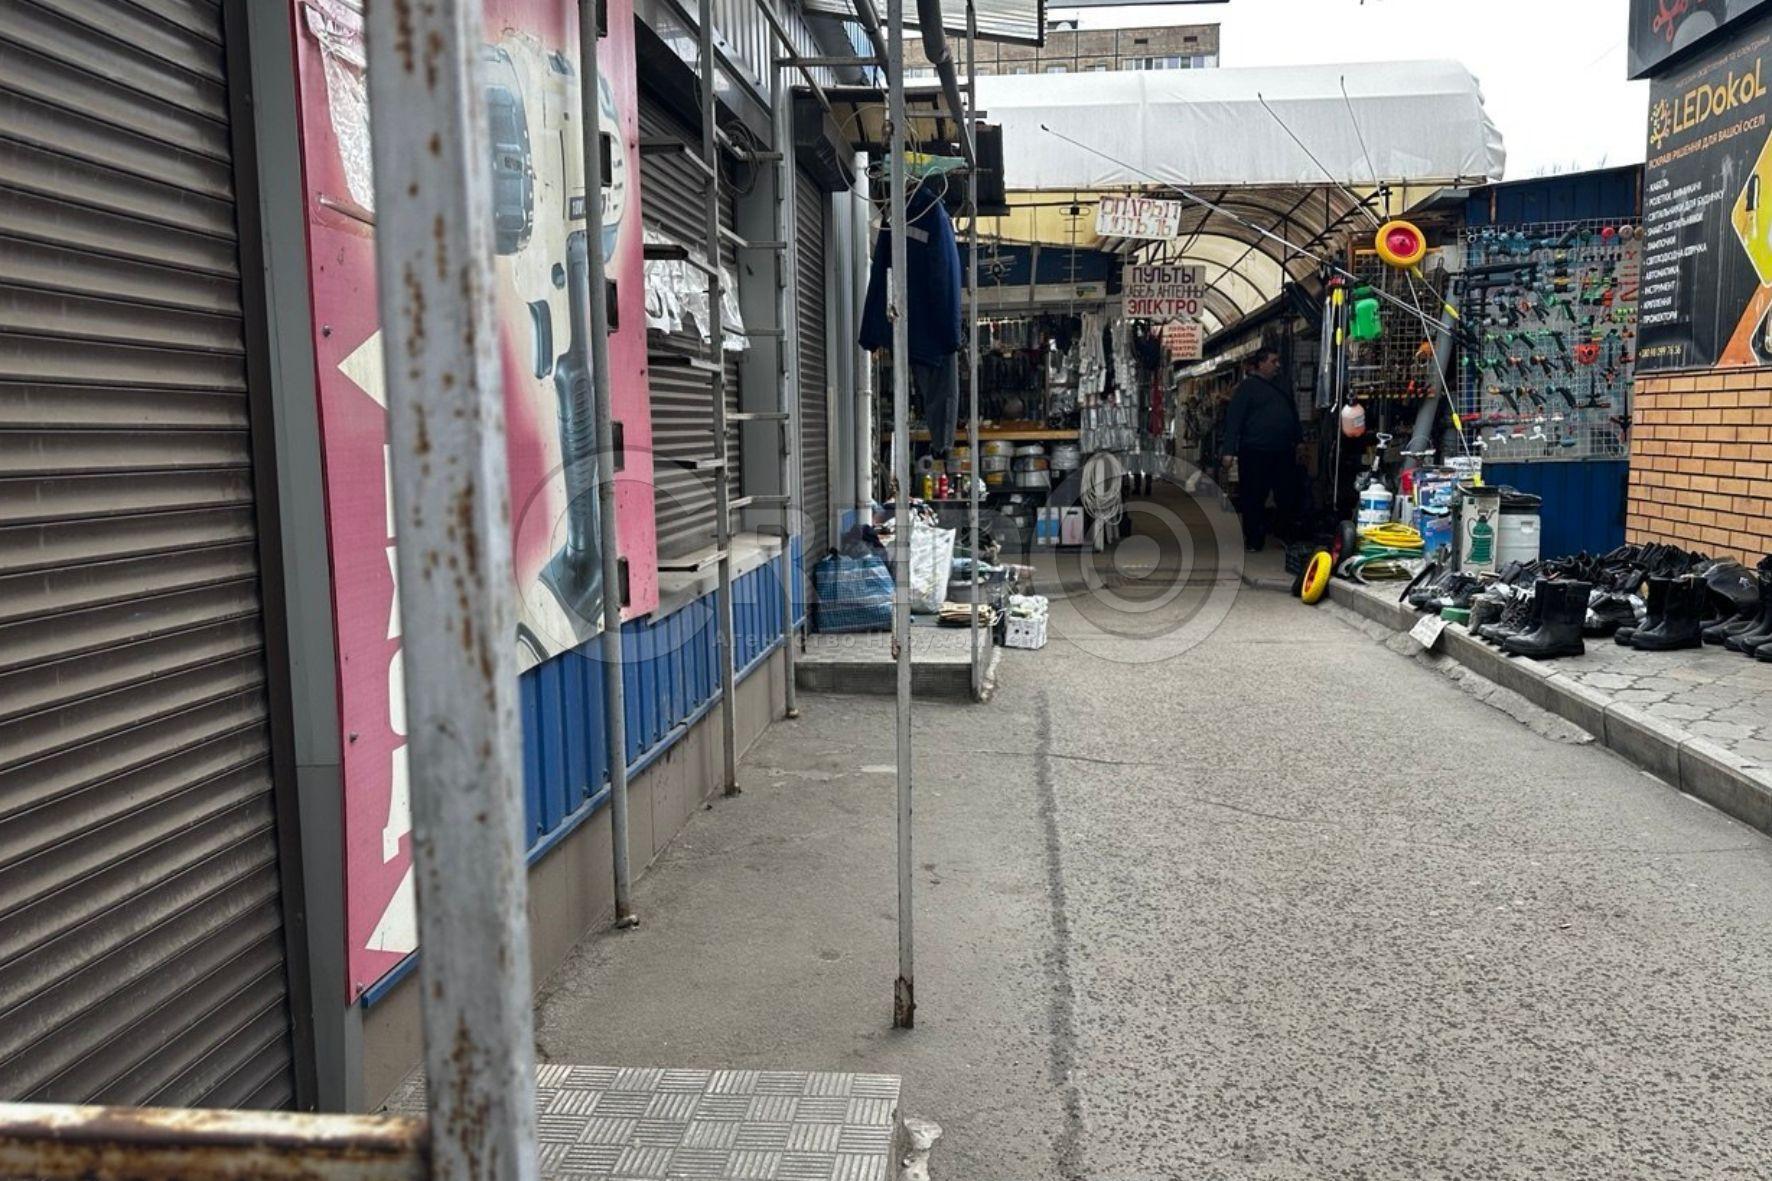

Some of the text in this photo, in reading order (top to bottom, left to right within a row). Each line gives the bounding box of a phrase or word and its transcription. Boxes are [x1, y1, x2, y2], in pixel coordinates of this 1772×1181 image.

[1132, 266, 1196, 284] ПУЛЬТЫ
[1125, 284, 1155, 298] АБЕЛЬ
[1127, 299, 1197, 315] ЭЛЕКТРО
